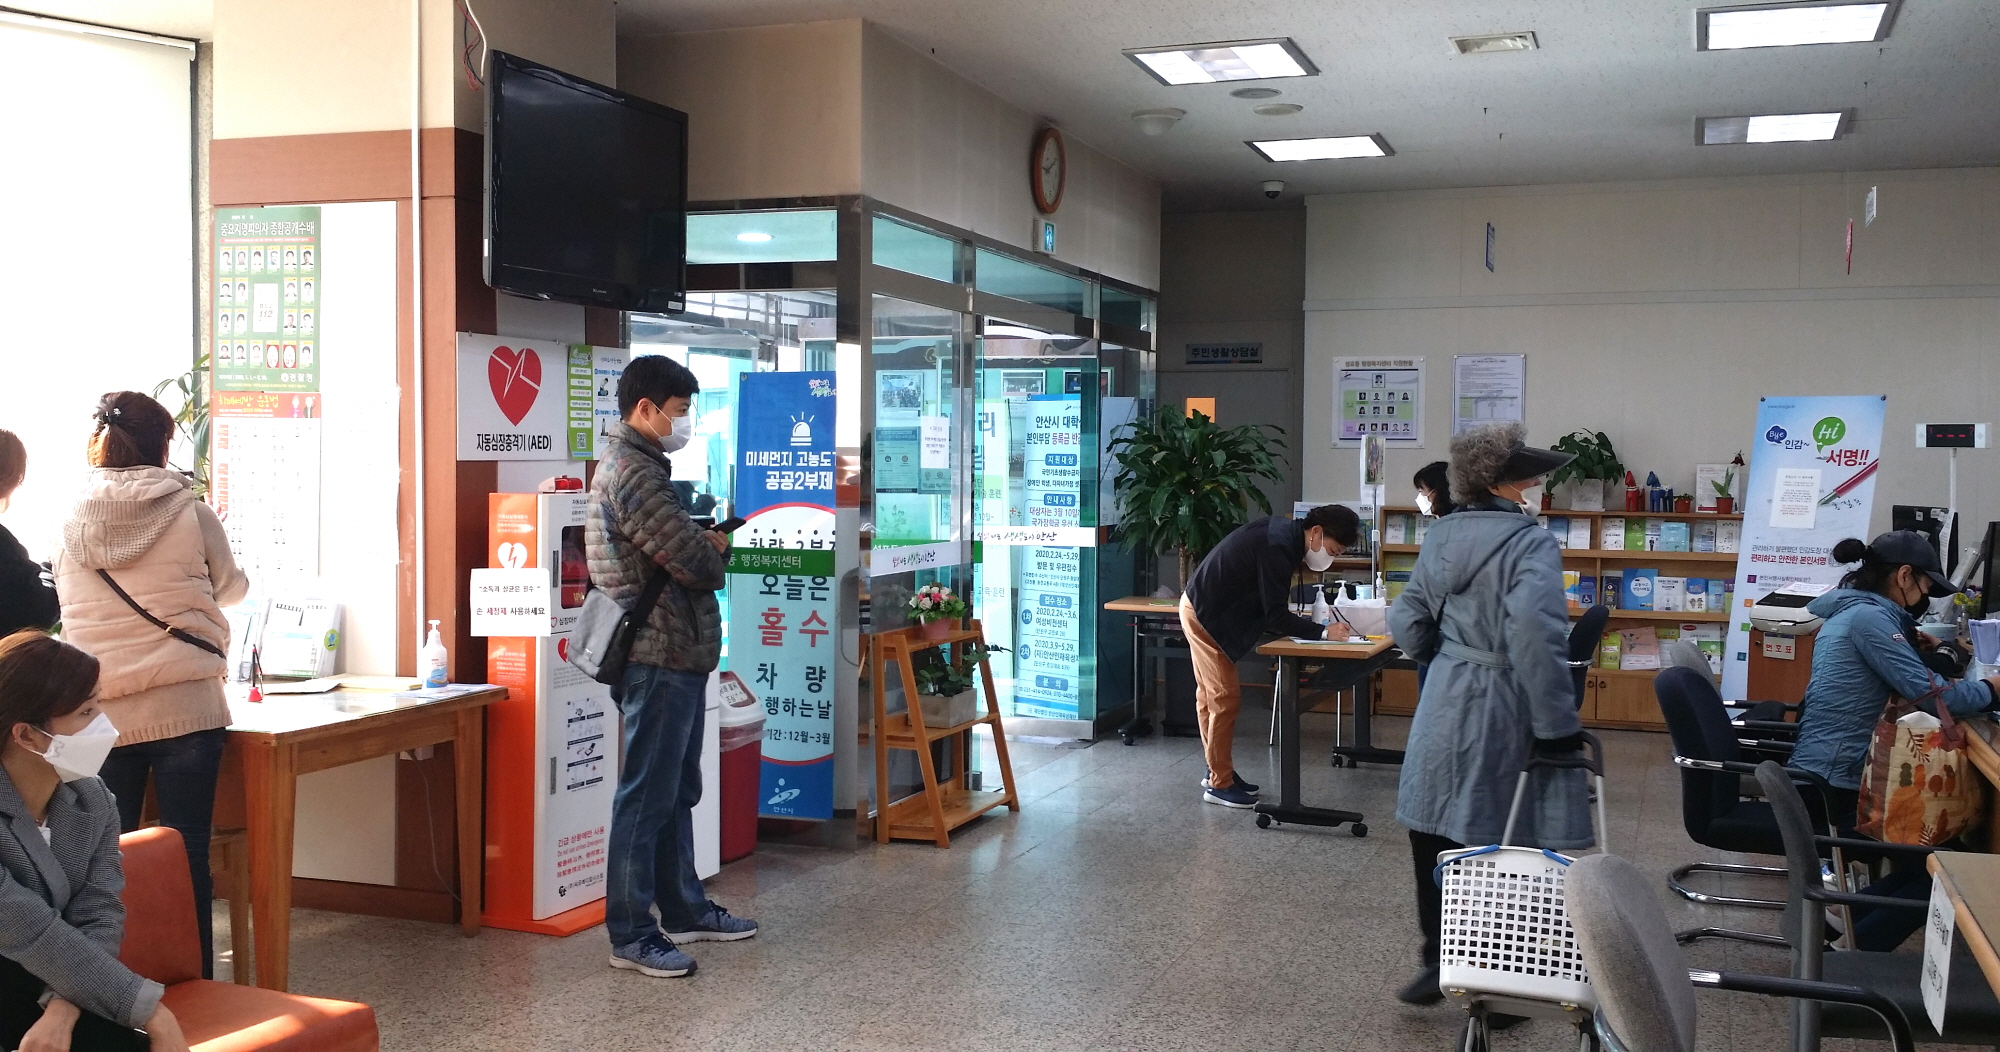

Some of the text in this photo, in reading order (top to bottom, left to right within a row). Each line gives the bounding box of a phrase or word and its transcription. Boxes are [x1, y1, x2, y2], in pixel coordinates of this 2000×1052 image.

[1191, 347, 1260, 358] 주민생활상담실
[1035, 415, 1081, 429] 안산시 대학
[1769, 430, 1785, 440] Bye
[1818, 423, 1839, 440] Hi
[476, 433, 552, 452] 자동심장충격기 (AED)
[1026, 432, 1051, 445] 본인부담
[1051, 432, 1070, 446] 등록금
[745, 451, 836, 467] 미세먼지 고농도
[1048, 455, 1076, 465] 지원대상
[1826, 449, 1869, 466] 서명!!
[766, 471, 834, 491] 공공2부제
[740, 551, 802, 570] 행정복지센터
[1037, 561, 1048, 571] 방문
[1056, 562, 1078, 573] 우편접수
[1751, 554, 1827, 566] 편리하고 안전한 본인서명
[760, 573, 829, 602] 오늘은
[476, 606, 546, 616] 손 세정제 사용하세요
[773, 806, 794, 814] 안산시
